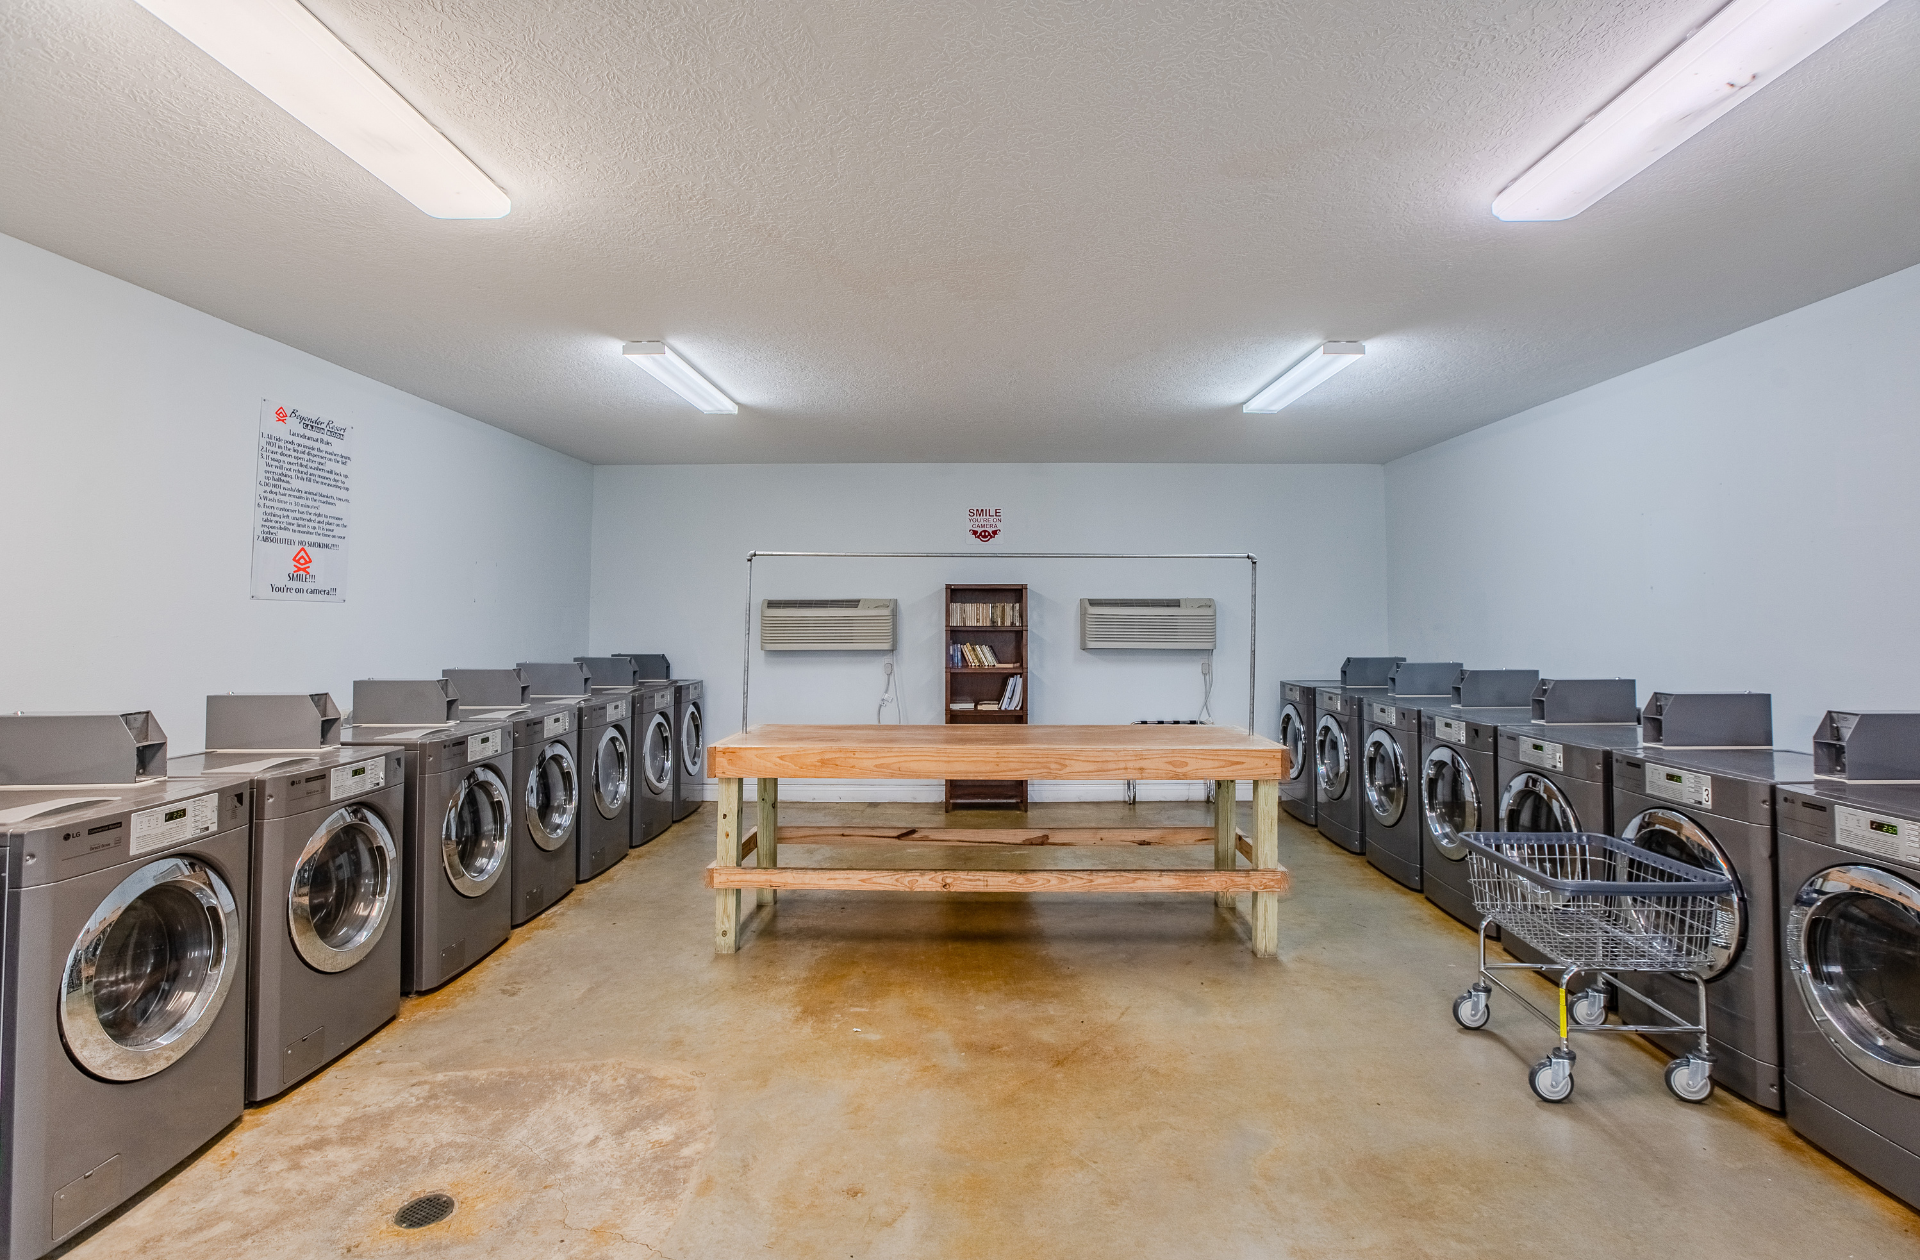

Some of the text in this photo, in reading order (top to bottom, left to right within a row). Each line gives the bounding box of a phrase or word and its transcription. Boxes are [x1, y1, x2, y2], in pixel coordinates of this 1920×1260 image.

[289, 409, 347, 433] Beyonder Resort
[284, 438, 295, 446] pods
[302, 443, 315, 451] inside
[324, 449, 339, 457] washer
[320, 438, 333, 446] Rules
[265, 446, 278, 455] Leave
[279, 450, 292, 458] doors
[293, 454, 305, 462] open
[306, 456, 316, 464] after
[292, 447, 305, 455] liquid
[306, 450, 326, 460] dispenser
[265, 460, 273, 468] We
[292, 467, 308, 475] refund
[317, 473, 331, 481] money
[309, 463, 325, 472] washers
[294, 473, 304, 481] Only
[320, 480, 341, 489] measuring
[263, 502, 275, 510] Every
[262, 510, 281, 518] clothing
[290, 514, 316, 523] unattended
[968, 509, 1001, 517] SMILE
[261, 522, 290, 532] responsibility
[261, 535, 295, 545] ABSOLUTELY
[287, 573, 316, 583] SMILE!!!
[270, 584, 294, 593] You're
[306, 587, 337, 596] camera!!!
[1704, 788, 1710, 803] 3
